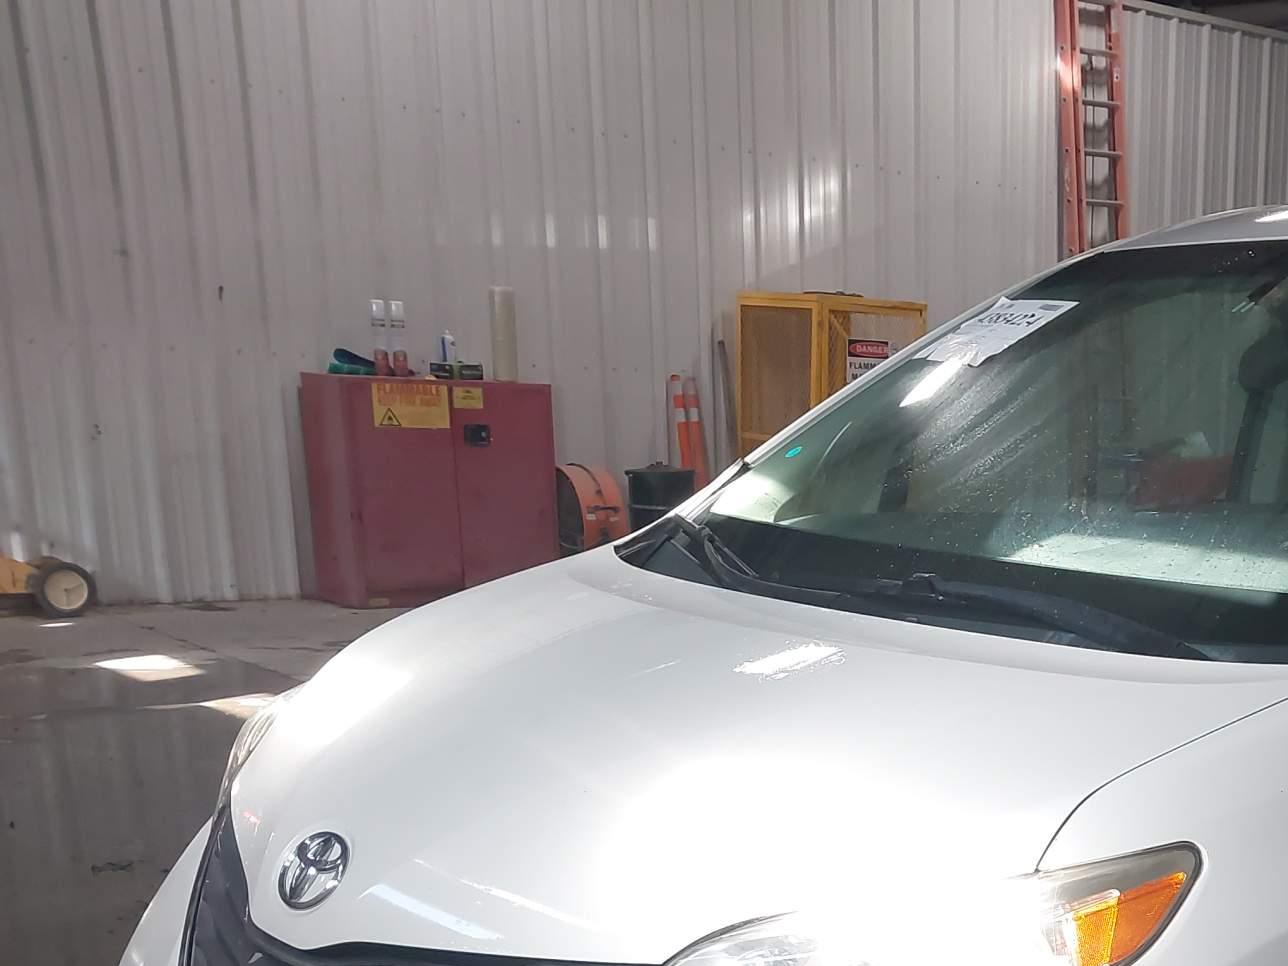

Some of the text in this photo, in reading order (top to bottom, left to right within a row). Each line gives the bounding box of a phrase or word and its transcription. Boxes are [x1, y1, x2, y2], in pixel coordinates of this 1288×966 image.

[856, 344, 887, 354] DANGER
[849, 361, 879, 370] FLAMM
[376, 384, 441, 396] FLAMMABLE
